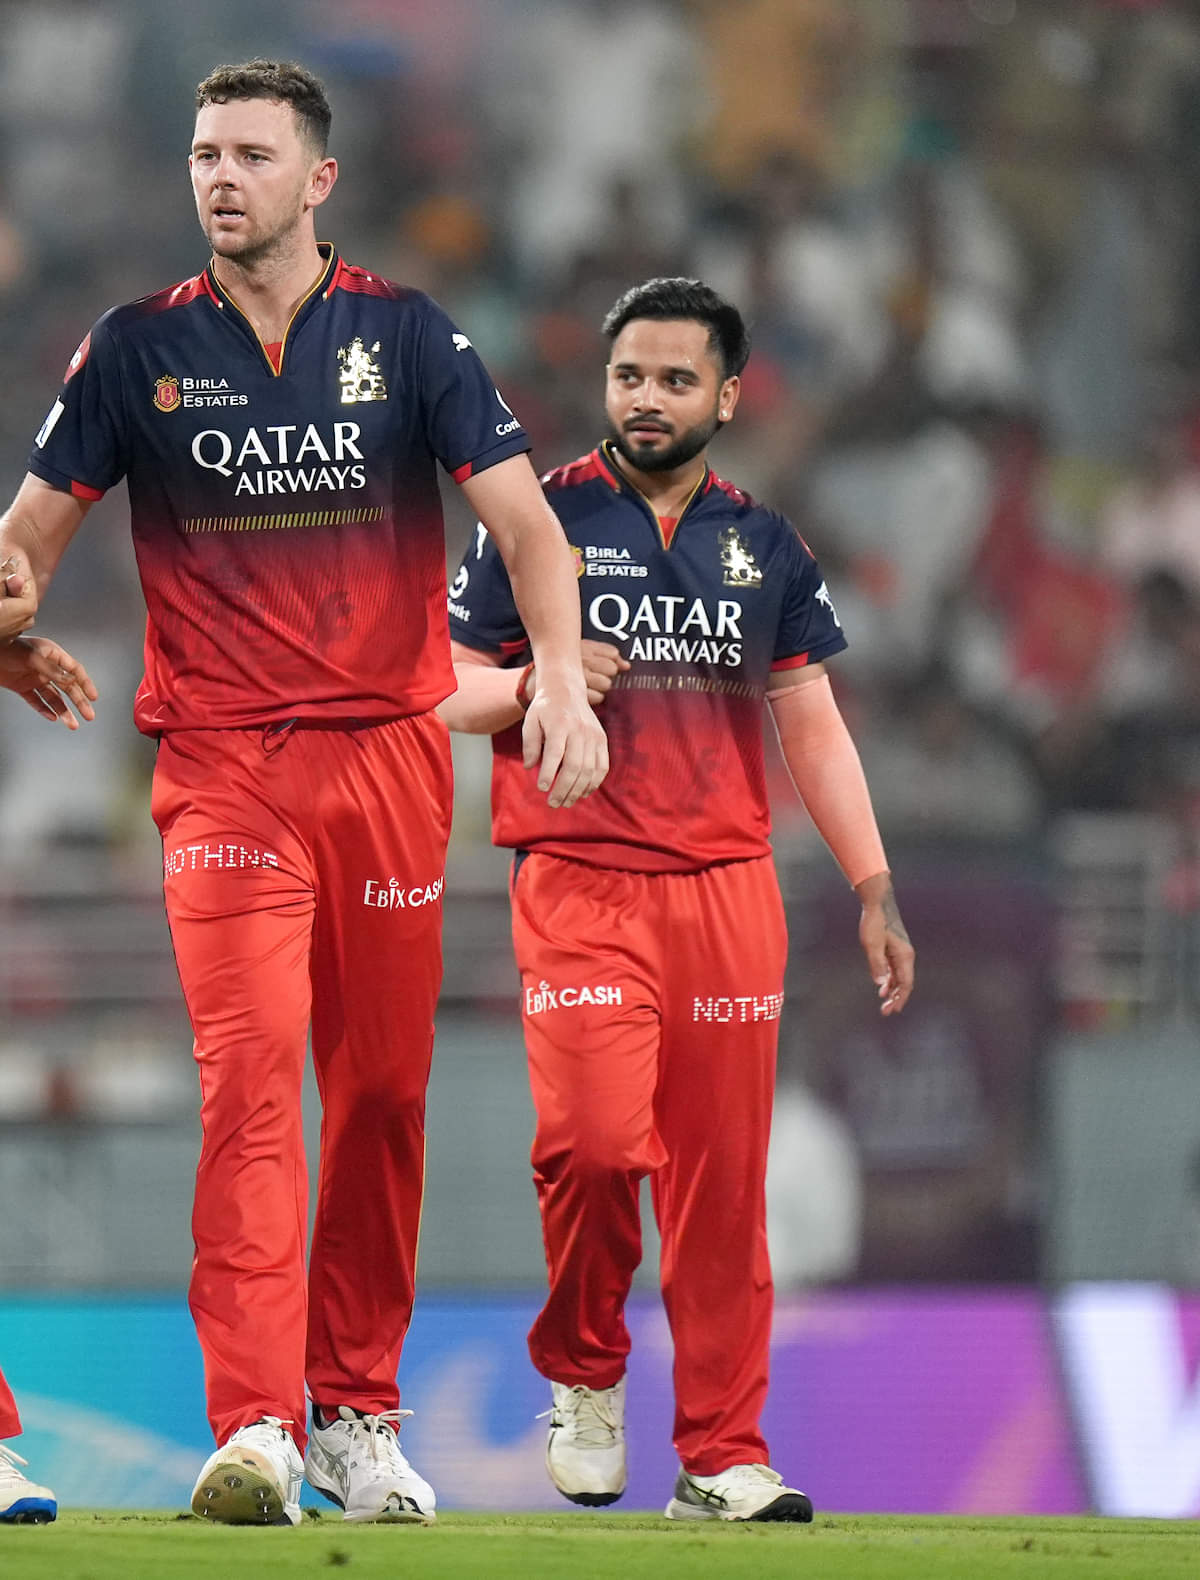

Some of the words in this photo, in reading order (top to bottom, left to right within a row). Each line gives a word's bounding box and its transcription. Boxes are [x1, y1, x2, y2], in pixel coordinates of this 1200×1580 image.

[182, 376, 230, 391] BIRLA
[182, 392, 249, 408] ESTATES
[191, 421, 365, 476] QATAR
[234, 464, 367, 497] AIRWAYS
[585, 545, 632, 560] BIRLA
[585, 562, 649, 577] ESTATES
[588, 593, 743, 641] QATAR
[629, 636, 742, 667] AIRWAYS
